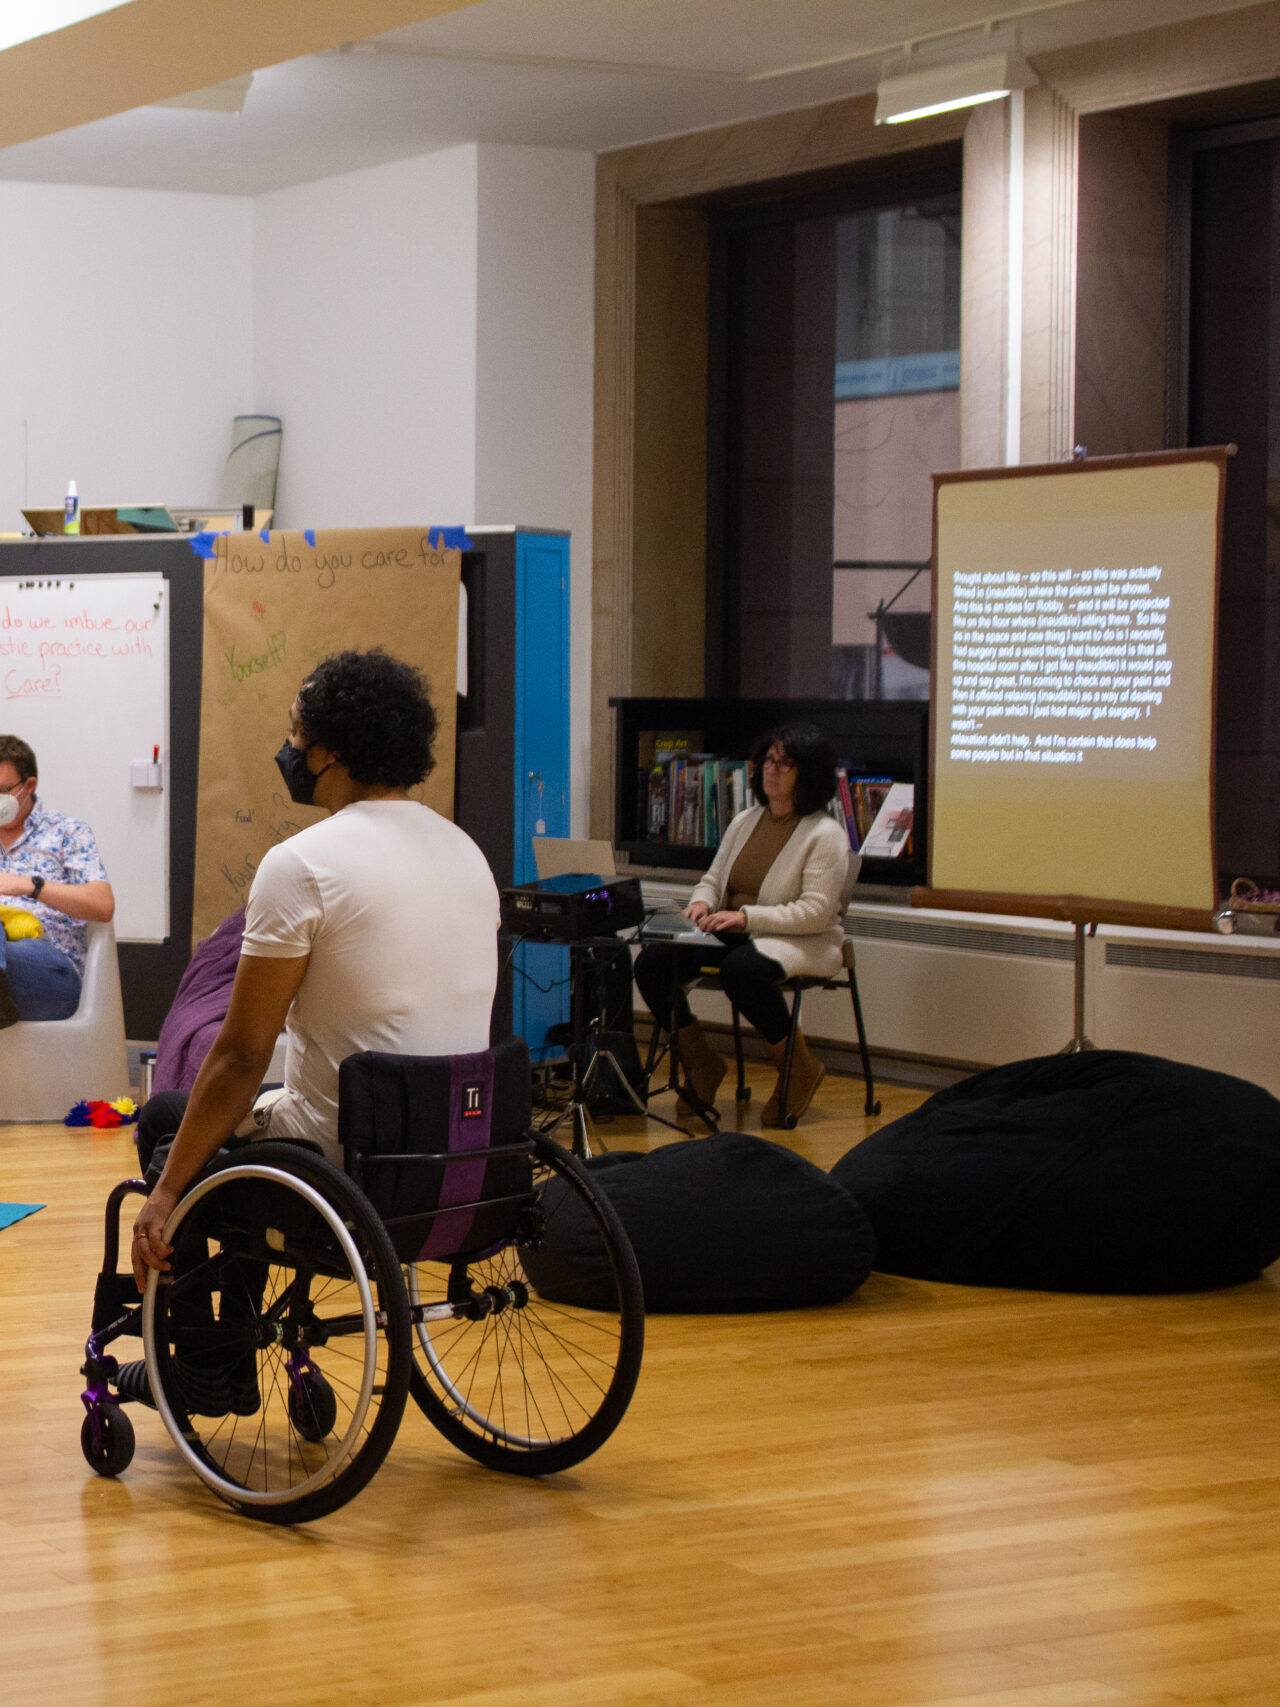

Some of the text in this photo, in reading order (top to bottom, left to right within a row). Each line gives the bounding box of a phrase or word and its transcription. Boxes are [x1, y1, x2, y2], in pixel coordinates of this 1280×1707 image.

[214, 535, 448, 589] How do you care for
[2, 605, 23, 630] do
[29, 617, 56, 630] we
[64, 610, 119, 631] imbue
[124, 618, 152, 632] our
[40, 638, 104, 670] practice
[111, 638, 152, 657] with
[5, 664, 62, 694] Care?
[221, 852, 256, 893] Your
[467, 1088, 479, 1108] Ti
